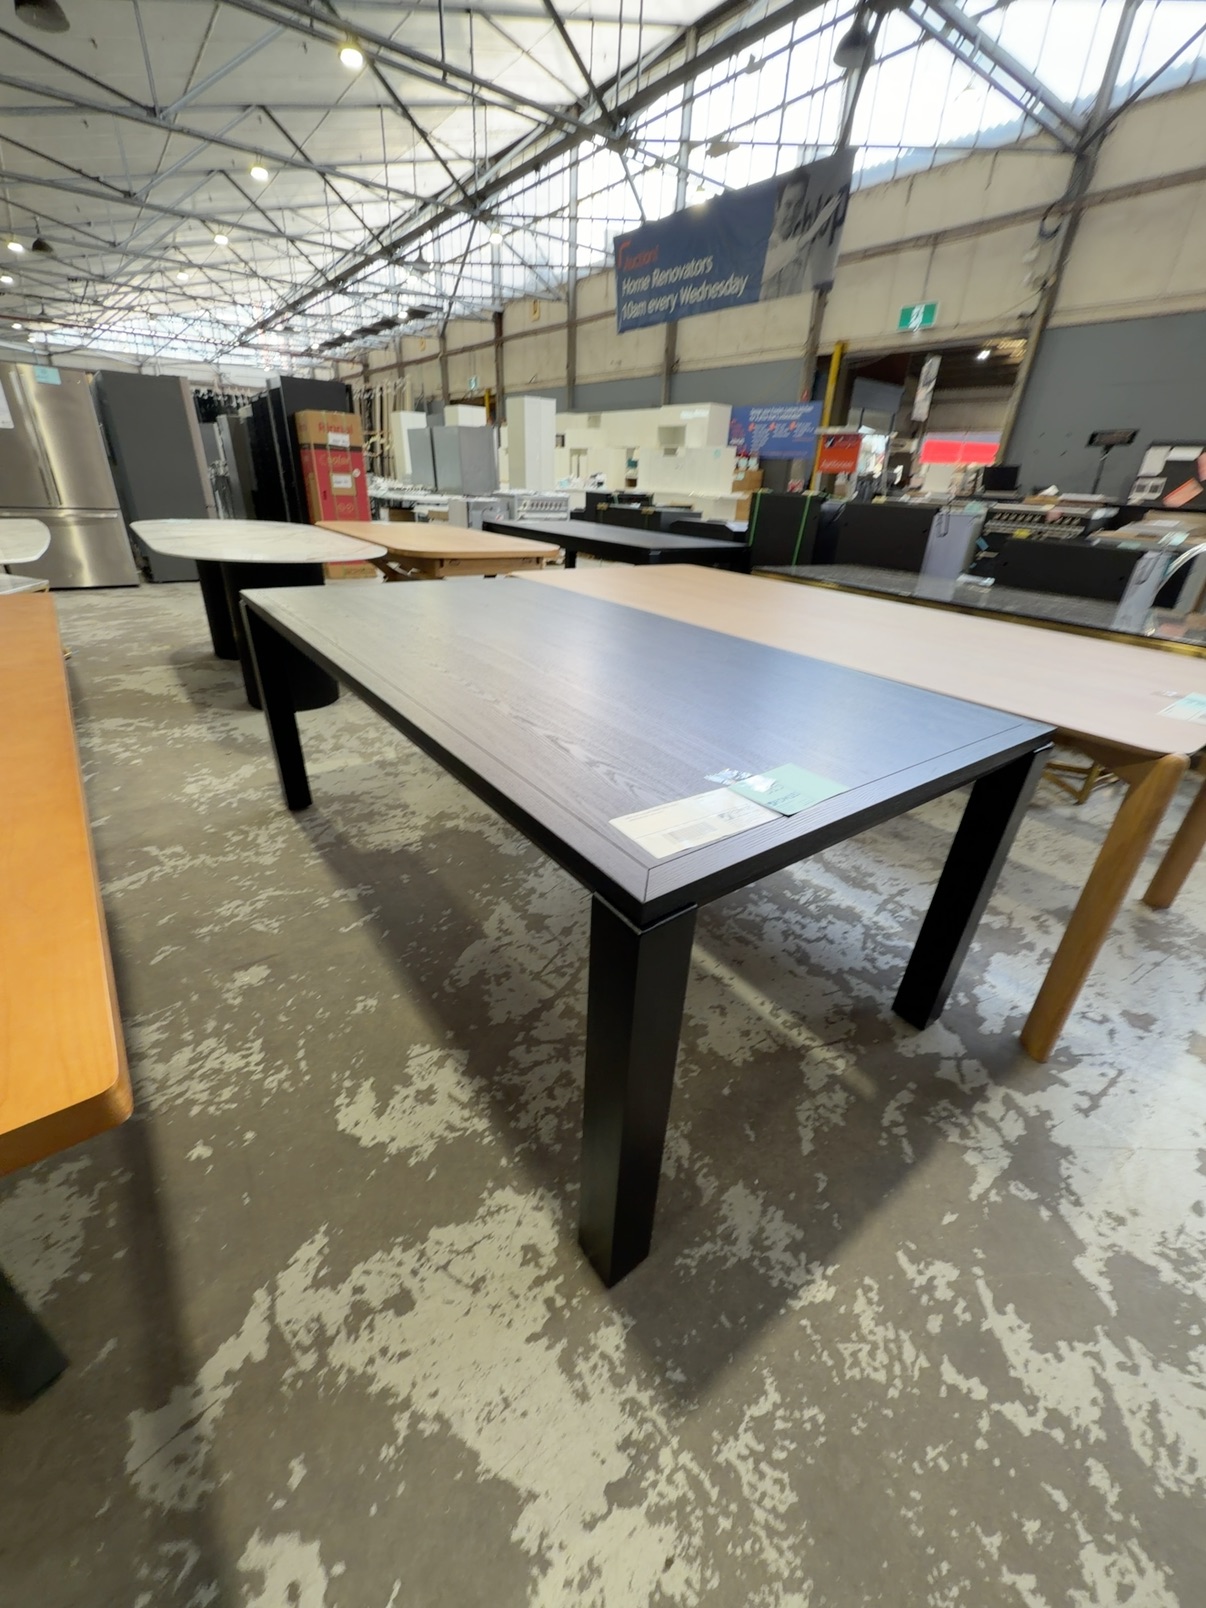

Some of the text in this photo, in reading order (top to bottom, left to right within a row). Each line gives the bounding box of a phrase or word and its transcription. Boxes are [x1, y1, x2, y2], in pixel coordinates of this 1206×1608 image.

[621, 273, 749, 320] 10am every Wednesday
[622, 256, 713, 297] Home Renovators
